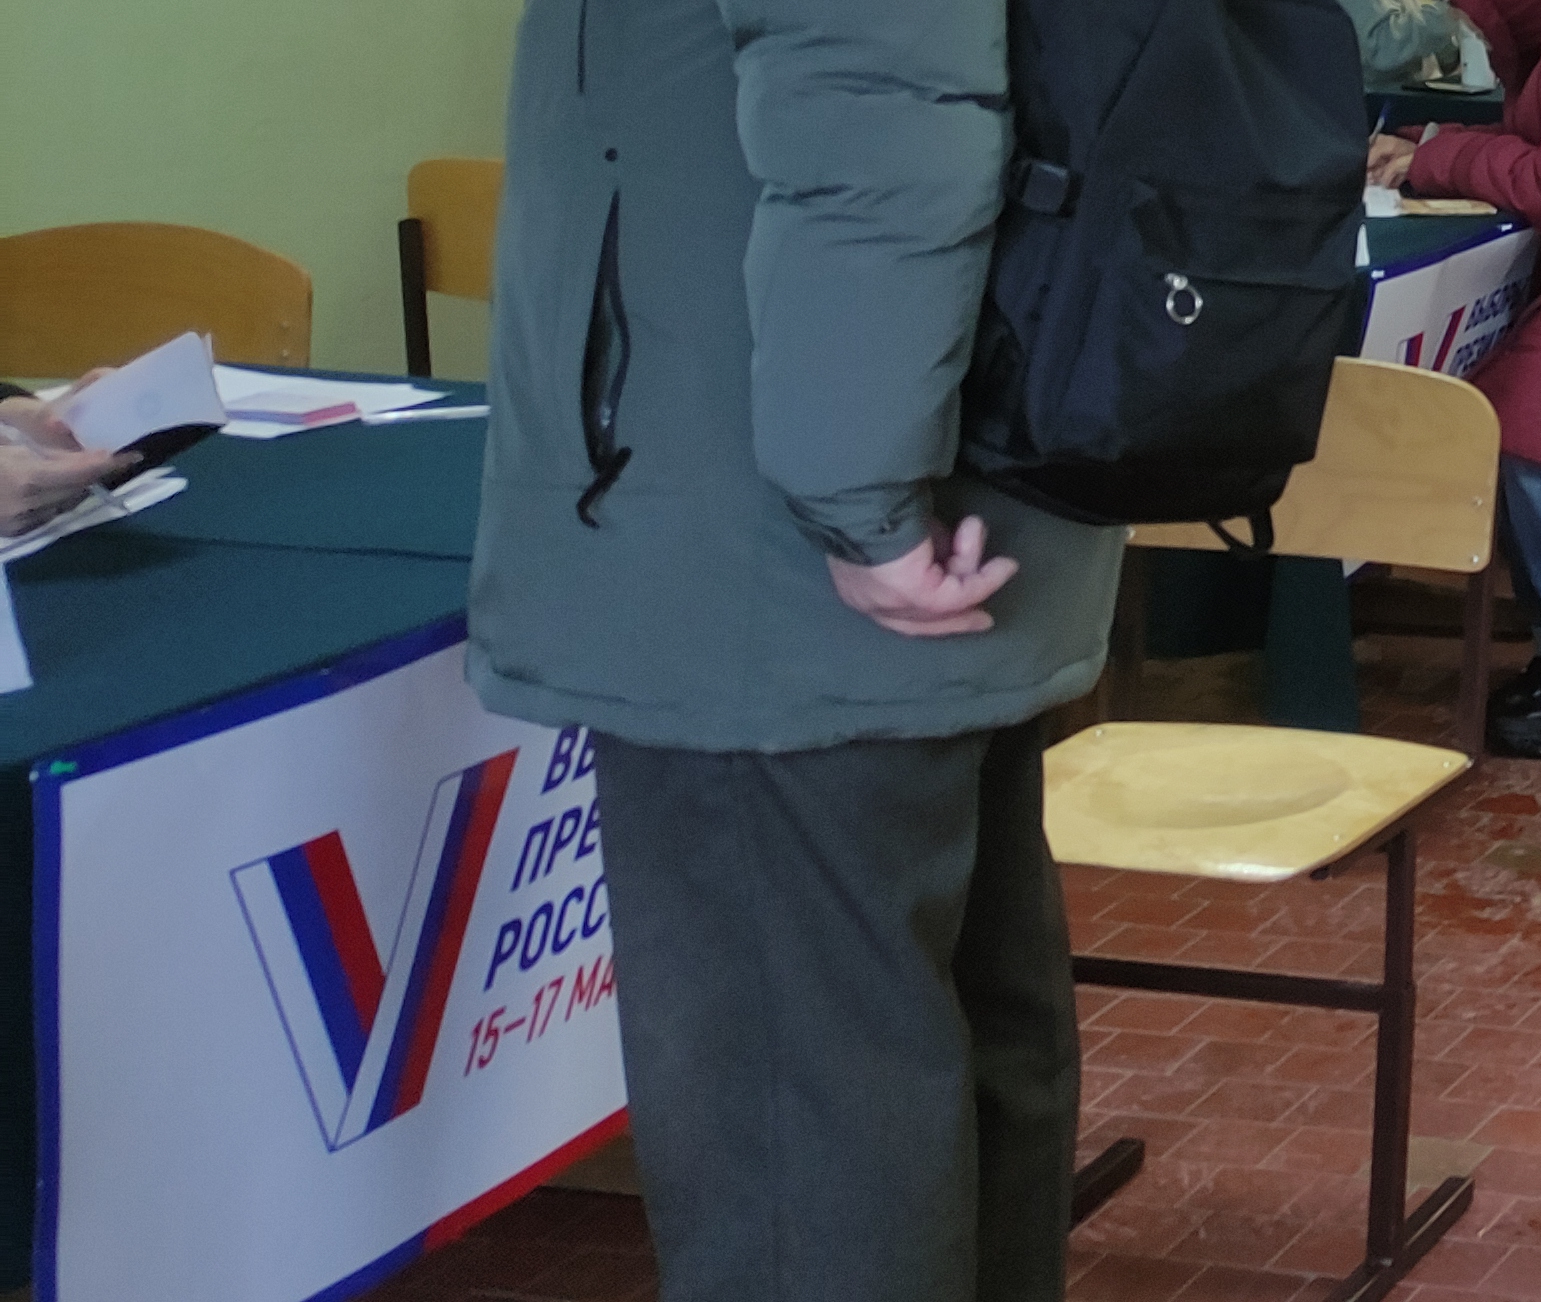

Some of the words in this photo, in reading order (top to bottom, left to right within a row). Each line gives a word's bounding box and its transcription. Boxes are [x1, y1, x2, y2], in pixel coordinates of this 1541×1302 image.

[510, 797, 601, 892] ПРЕ
[483, 874, 607, 992] РОСС
[565, 955, 618, 1023] МА
